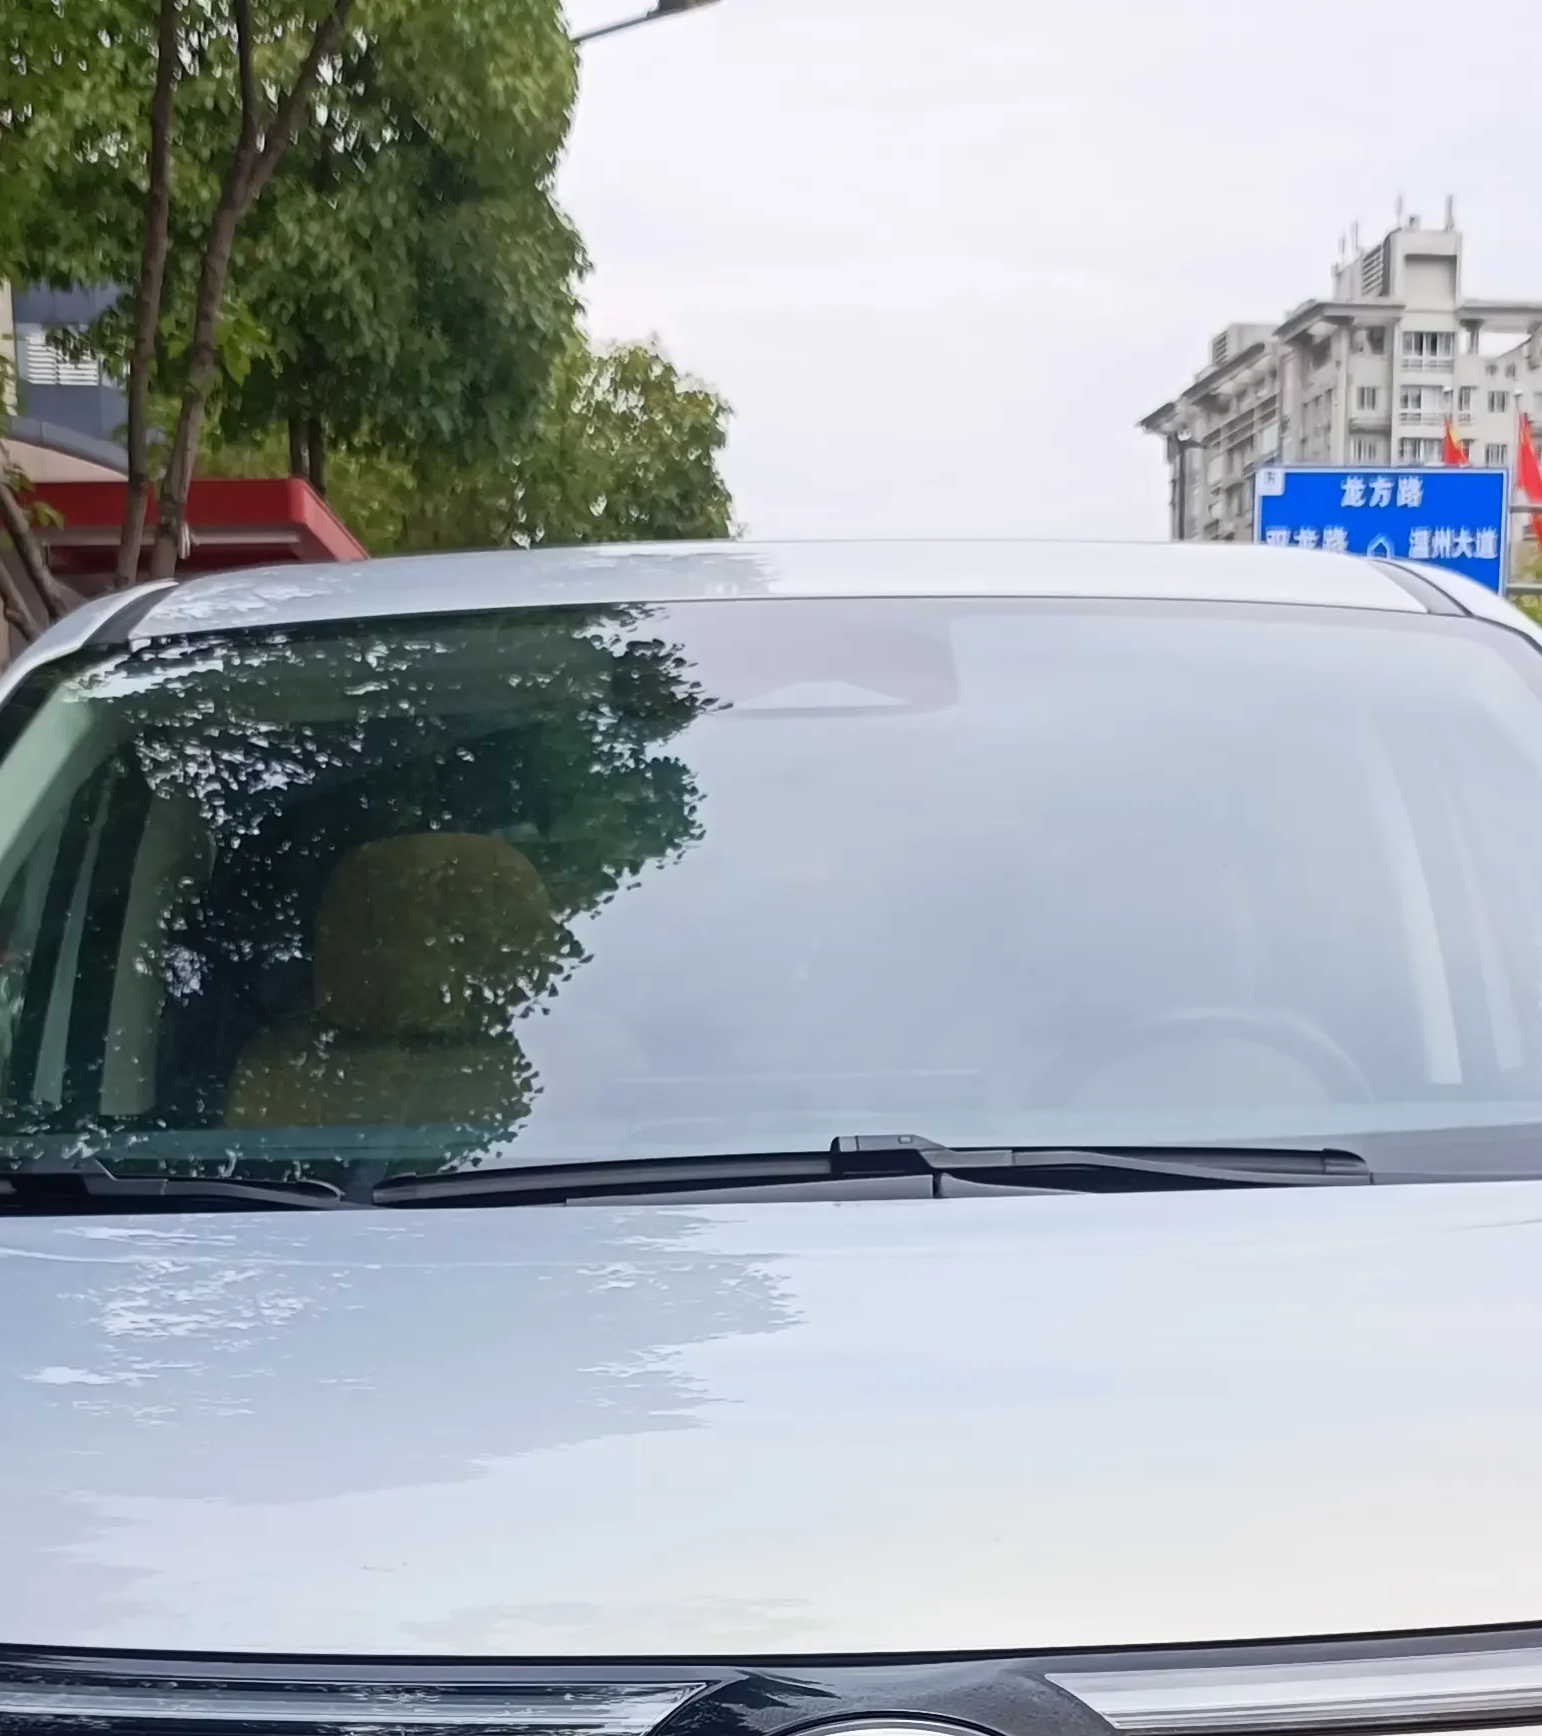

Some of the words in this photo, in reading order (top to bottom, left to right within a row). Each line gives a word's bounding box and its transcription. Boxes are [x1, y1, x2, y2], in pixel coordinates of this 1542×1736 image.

[1340, 475, 1424, 508] 龙方路
[1408, 525, 1499, 559] 温州大道
